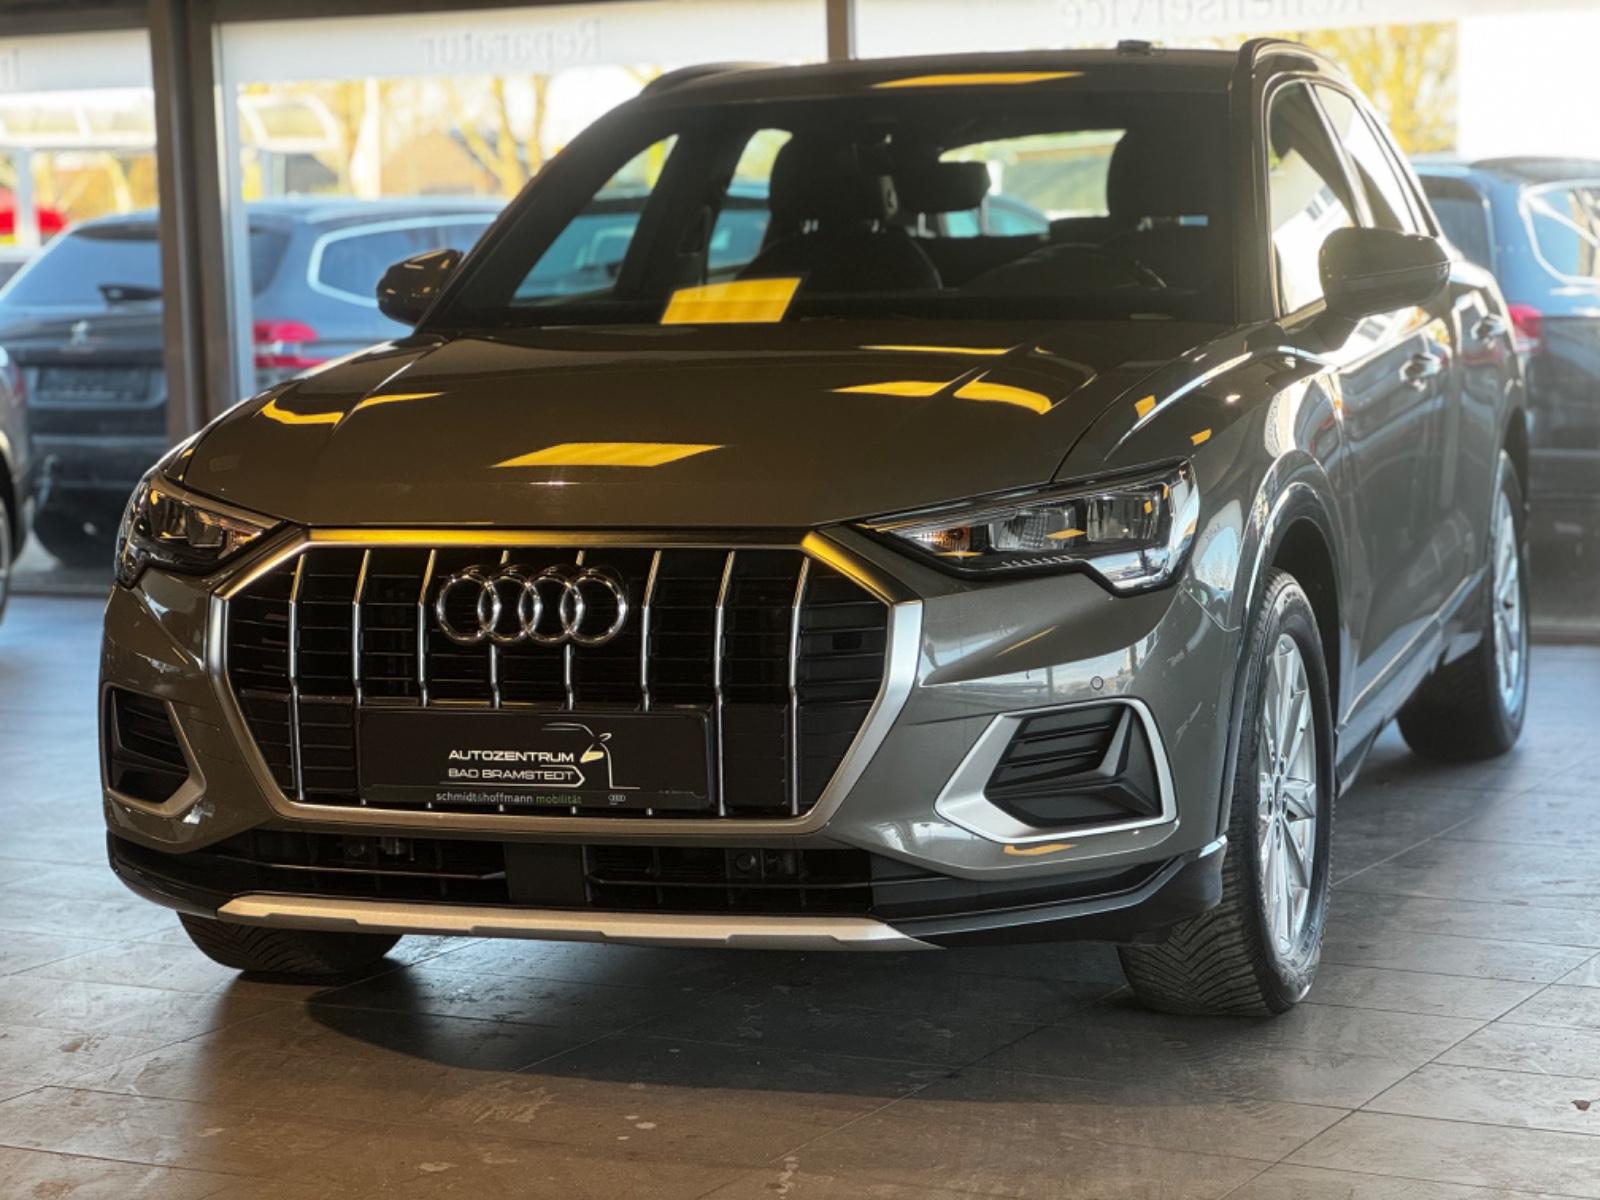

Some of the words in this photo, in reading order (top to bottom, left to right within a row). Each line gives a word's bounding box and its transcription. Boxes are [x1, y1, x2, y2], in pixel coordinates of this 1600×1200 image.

[448, 749, 575, 763] AUTOZENTRUM
[448, 767, 479, 779] BAD
[482, 769, 575, 781] BRAMSTEDT
